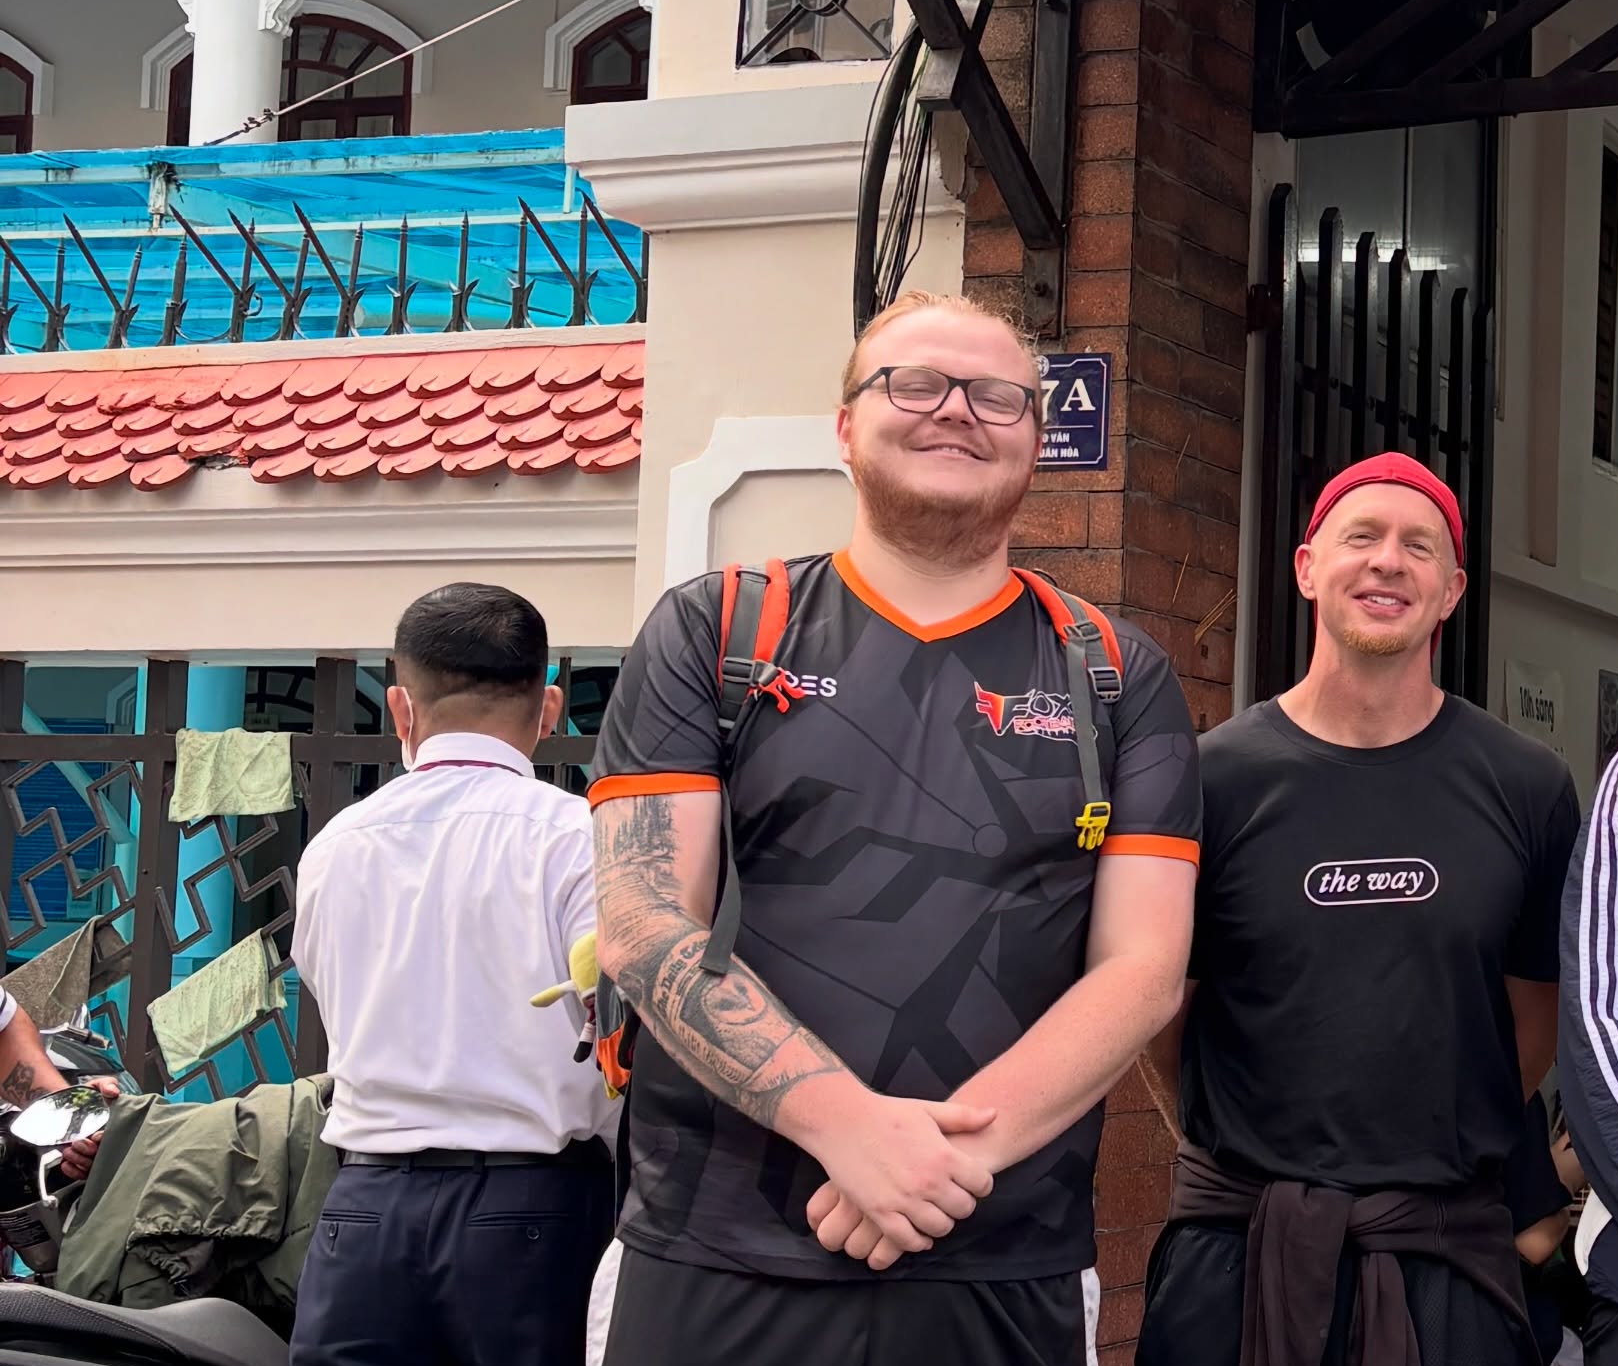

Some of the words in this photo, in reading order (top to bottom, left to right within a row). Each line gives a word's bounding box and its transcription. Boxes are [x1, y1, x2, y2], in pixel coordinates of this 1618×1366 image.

[1040, 378, 1097, 424] 7A
[1318, 867, 1361, 894] the
[1366, 870, 1425, 896] way
